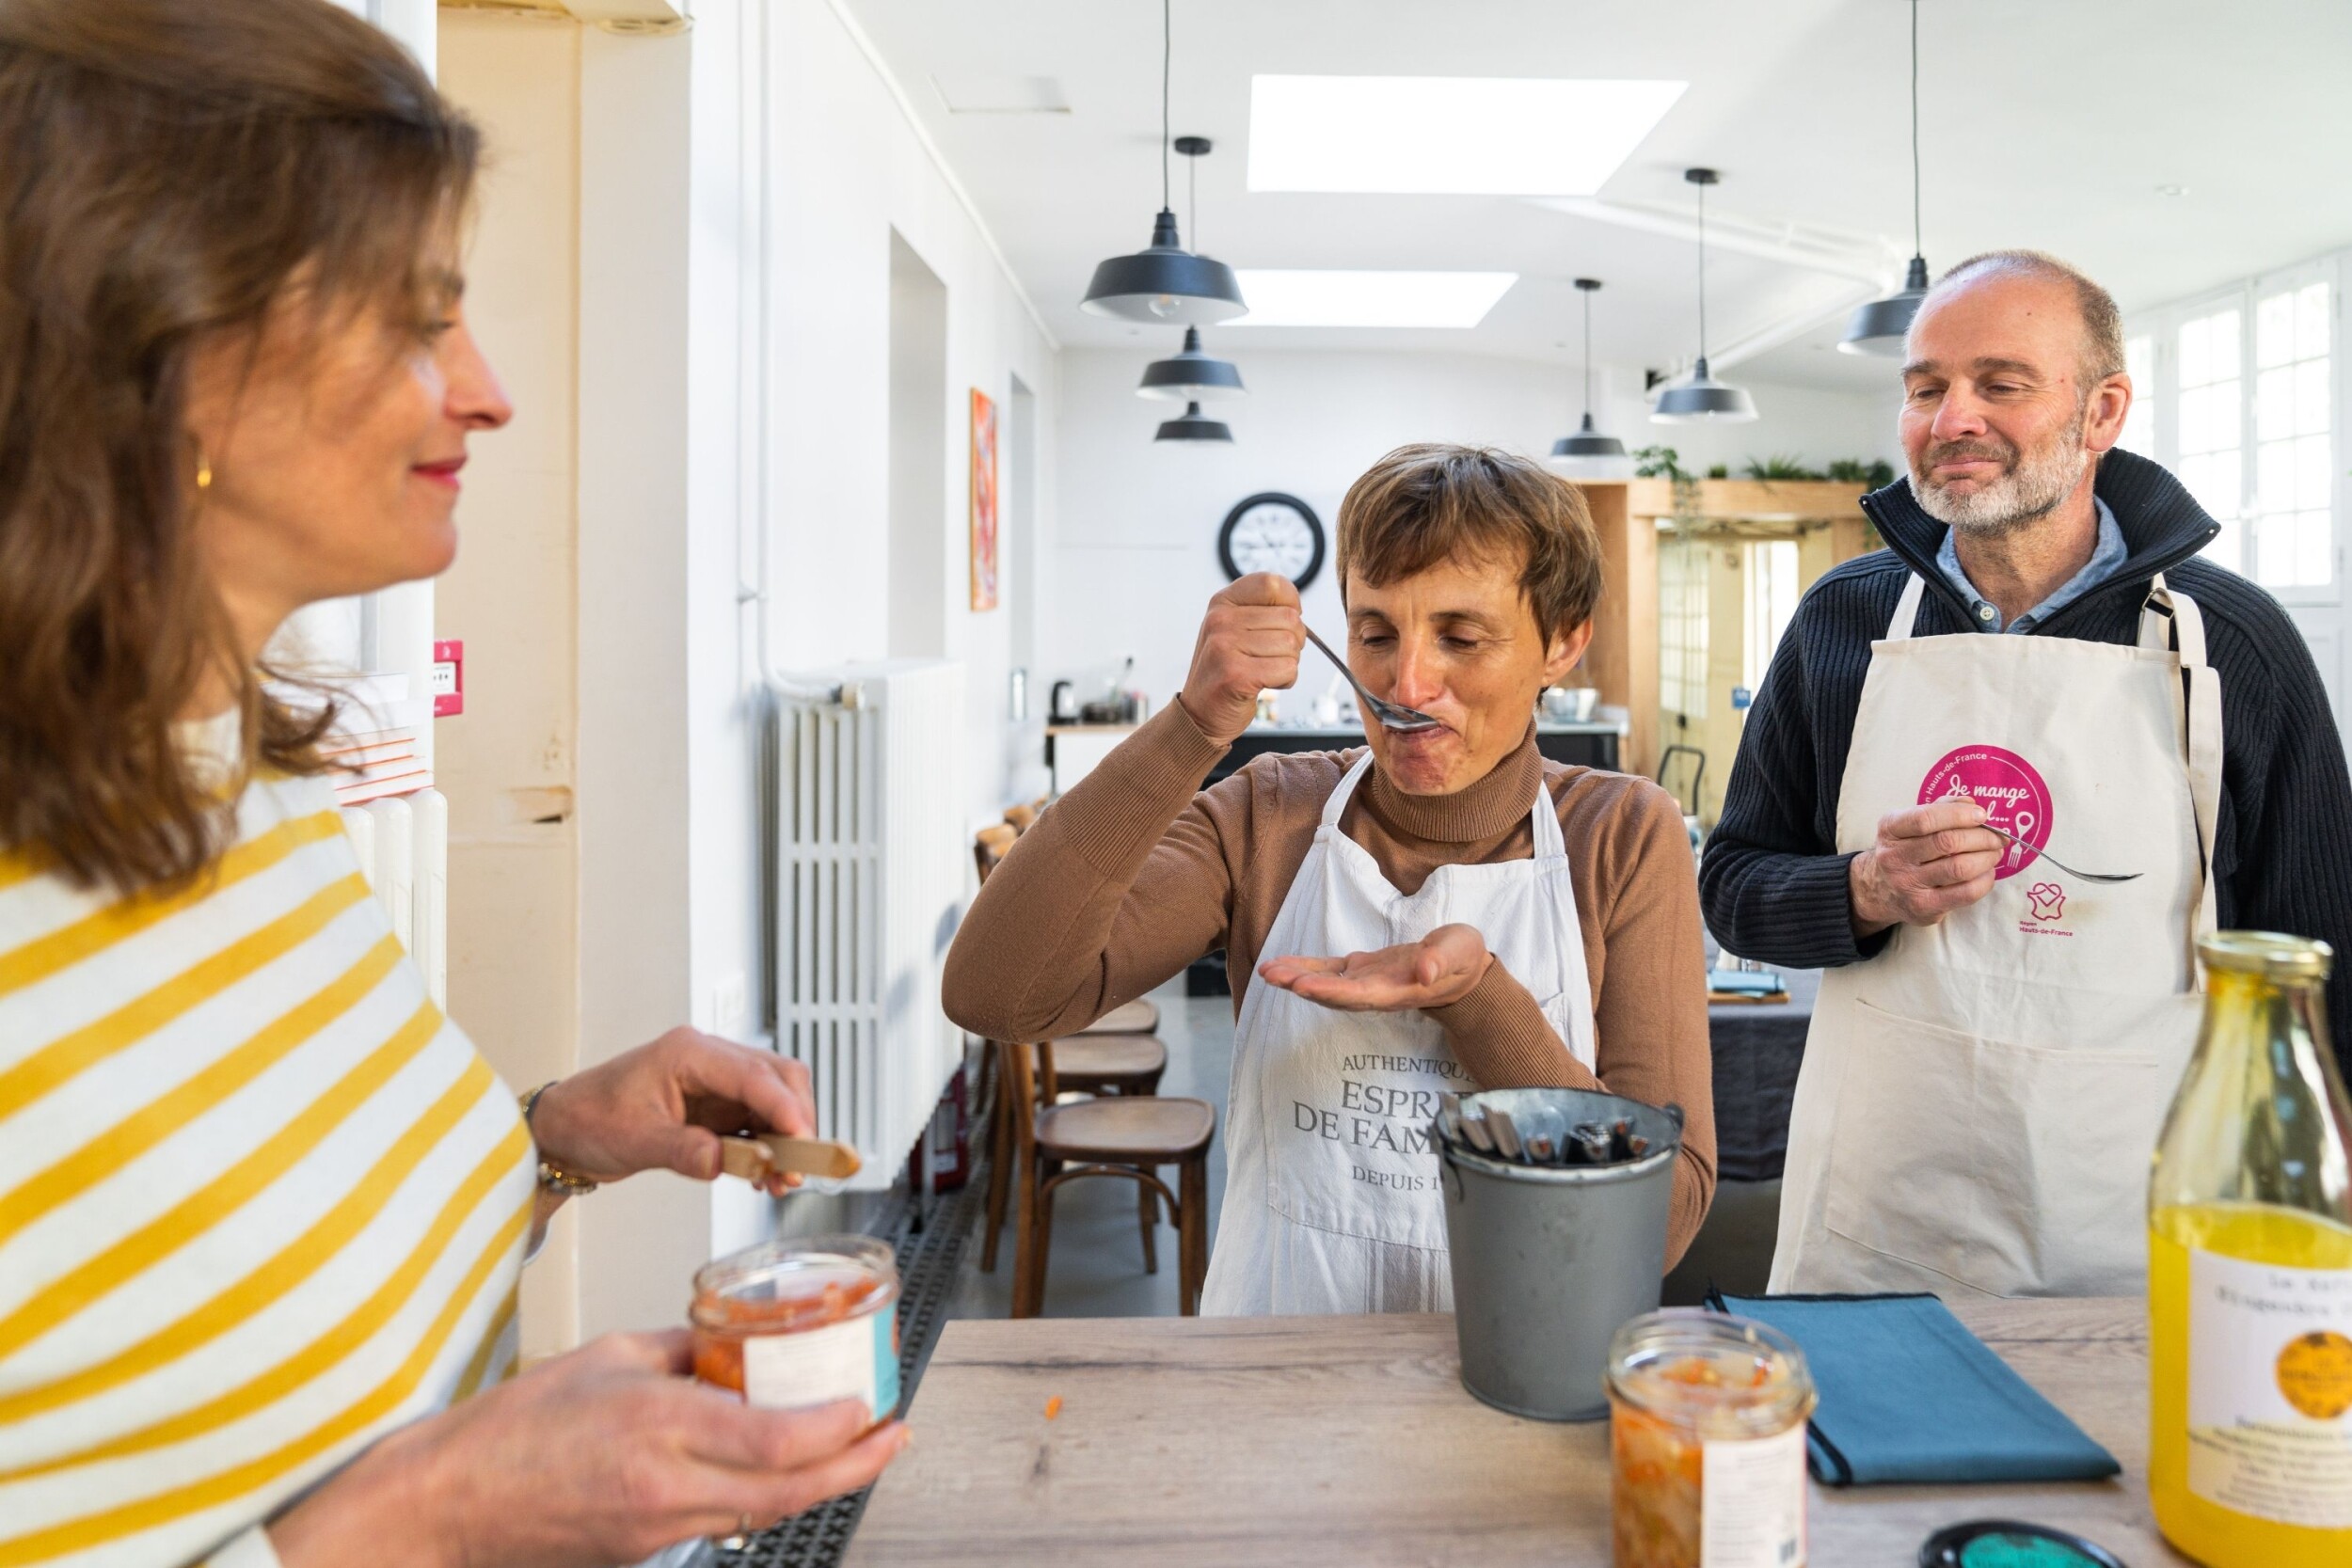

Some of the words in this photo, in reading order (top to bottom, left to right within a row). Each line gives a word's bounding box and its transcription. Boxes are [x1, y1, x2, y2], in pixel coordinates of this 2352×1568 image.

[1926, 752, 1988, 795] Hauts-de-France
[1973, 784, 2030, 808] mange
[2019, 927, 2074, 937] Hauts-de-France
[1293, 1100, 1340, 1141] DE
[1351, 1117, 1438, 1155] FAM
[1353, 1165, 1423, 1191] DEPUIS
[1431, 1177, 1438, 1190] 1
